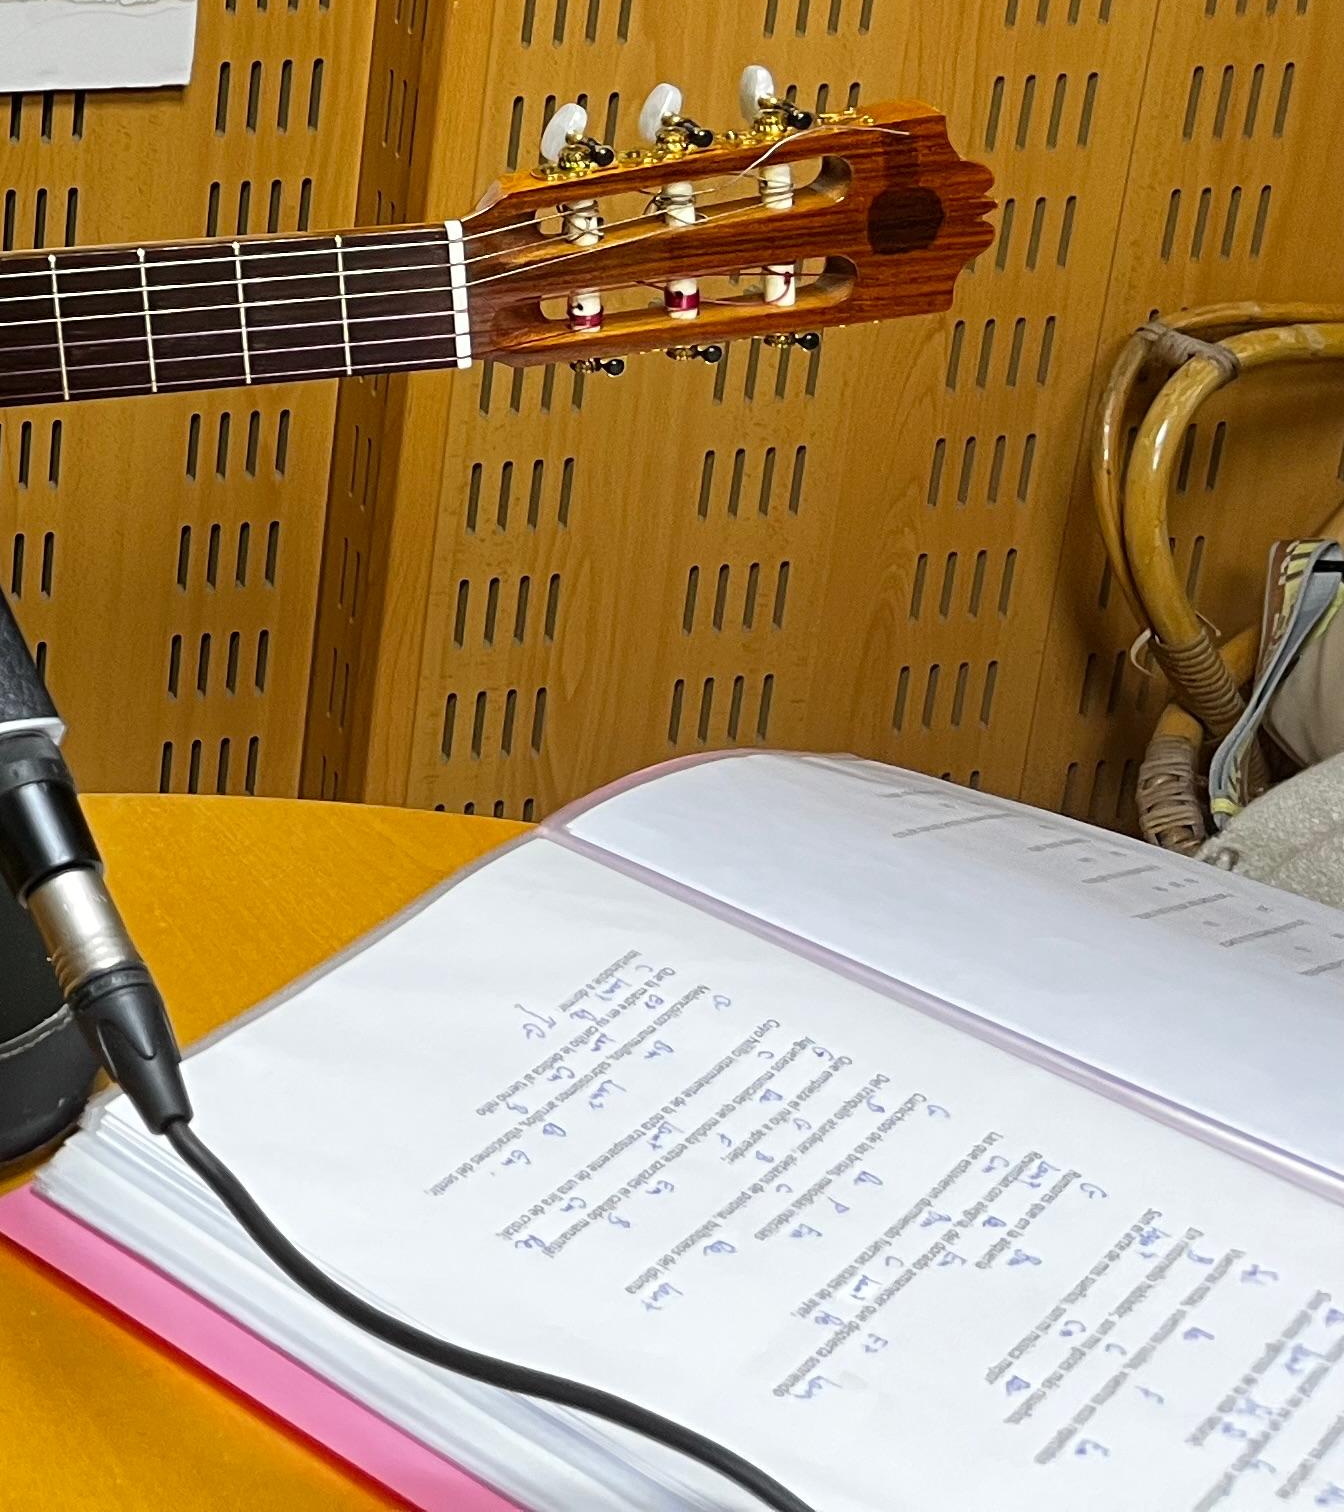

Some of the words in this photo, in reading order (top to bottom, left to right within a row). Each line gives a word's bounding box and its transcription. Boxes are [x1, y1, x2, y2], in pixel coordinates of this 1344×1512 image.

[653, 967, 676, 982] Que
[644, 980, 660, 988] la
[617, 987, 653, 1010] madre
[606, 1009, 621, 1019] en
[753, 1019, 781, 1038] Cuyo
[560, 1046, 577, 1054] le
[532, 1053, 565, 1075] dedica
[829, 1056, 852, 1072] Que
[523, 1074, 536, 1085] al
[796, 1071, 833, 1101] empieza
[869, 1074, 890, 1090] Del
[732, 1071, 775, 1105] musicales
[476, 1100, 500, 1116] niño
[661, 1106, 677, 1114] la
[670, 1097, 686, 1107] de
[787, 1100, 801, 1111] el
[833, 1087, 876, 1120] tranquilo
[715, 1104, 736, 1119] que
[877, 1093, 927, 1133] Cuchicheos
[641, 1113, 665, 1131] nota
[762, 1123, 773, 1131] a
[684, 1117, 720, 1144] modula
[865, 1132, 883, 1143] de
[982, 1132, 1004, 1146] Las
[586, 1129, 647, 1172] transparente
[660, 1143, 688, 1162] entre
[854, 1142, 875, 1155] las
[966, 1144, 987, 1160] que
[456, 1163, 474, 1178] del
[574, 1170, 592, 1181] de
[627, 1160, 666, 1189] zarzales
[556, 1179, 579, 1195] una
[928, 1159, 972, 1199] estuvieron
[1040, 1170, 1082, 1204] Rumores
[617, 1187, 631, 1198] el
[748, 1183, 764, 1194] de
[982, 1186, 1003, 1202] con
[528, 1205, 545, 1216] de
[587, 1194, 622, 1220] callado
[1025, 1203, 1046, 1219] que
[884, 1198, 933, 1239] durmiendo
[1014, 1218, 1030, 1230] en
[541, 1218, 590, 1259] manantial
[940, 1229, 960, 1245] del
[1006, 1229, 1024, 1238] la
[854, 1238, 891, 1266] fuerzas
[912, 1242, 947, 1270] dorado
[656, 1254, 676, 1271] del
[624, 1266, 664, 1294] idioma
[873, 1269, 917, 1307] amanecer
[815, 1288, 833, 1300] de
[855, 1305, 878, 1322] que
[816, 1320, 861, 1358] despierta
